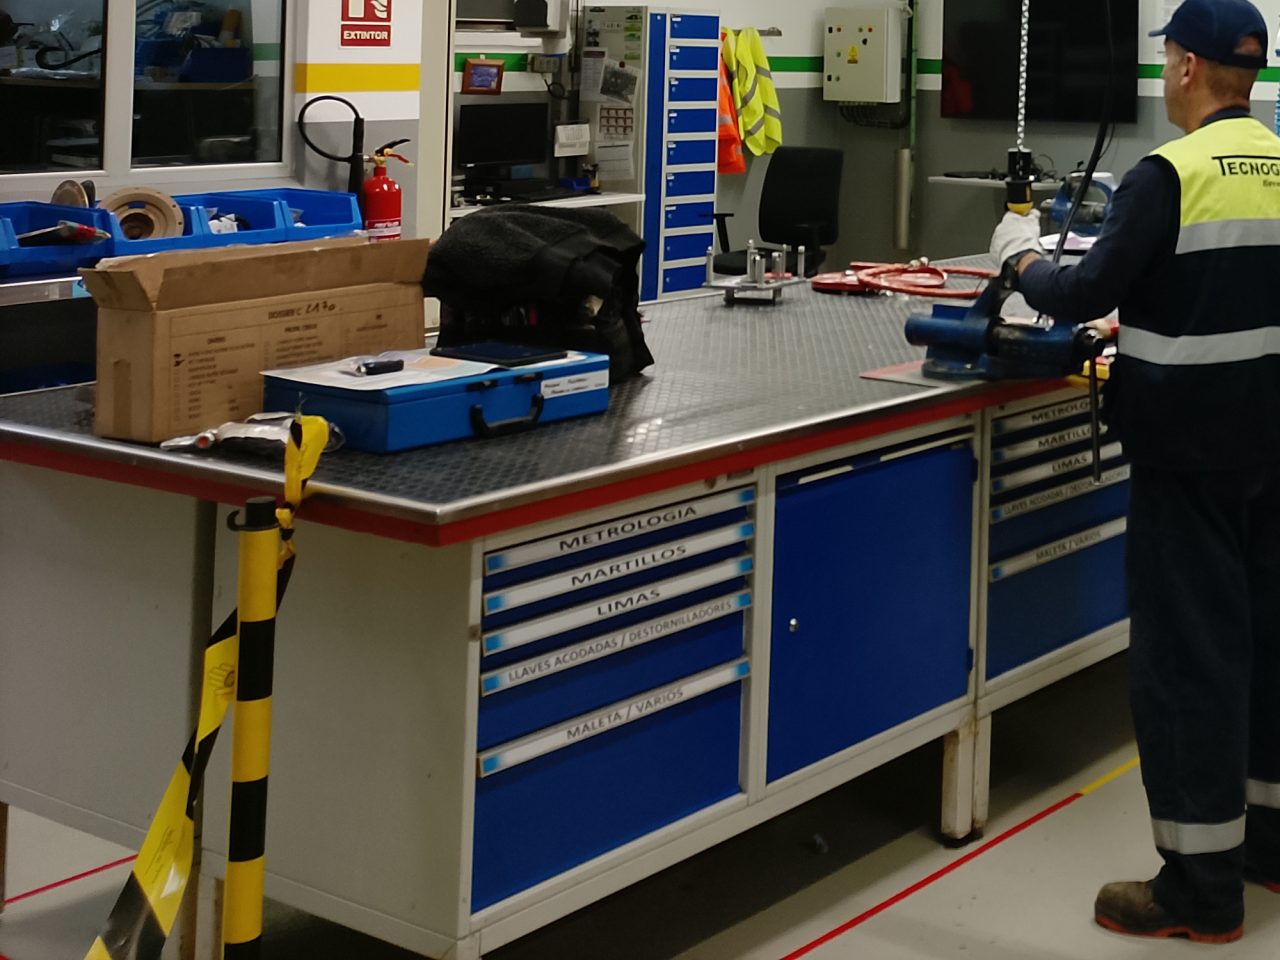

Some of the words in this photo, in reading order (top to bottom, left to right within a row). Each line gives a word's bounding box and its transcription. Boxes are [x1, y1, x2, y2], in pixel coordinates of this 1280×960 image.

[343, 30, 389, 40] EXTINTOR
[1051, 454, 1088, 473] LIMAS
[559, 506, 697, 551] METROLOGIA
[571, 545, 687, 586] MARTILLOS
[597, 589, 660, 615] LIMAS
[508, 660, 550, 682] LLAVES
[554, 639, 618, 668] ACODADAS
[619, 633, 626, 648] /
[629, 600, 732, 641] DESTORNILLADORES
[566, 711, 622, 740] MALETA
[626, 703, 633, 719] /
[636, 688, 684, 713] VARIOS
